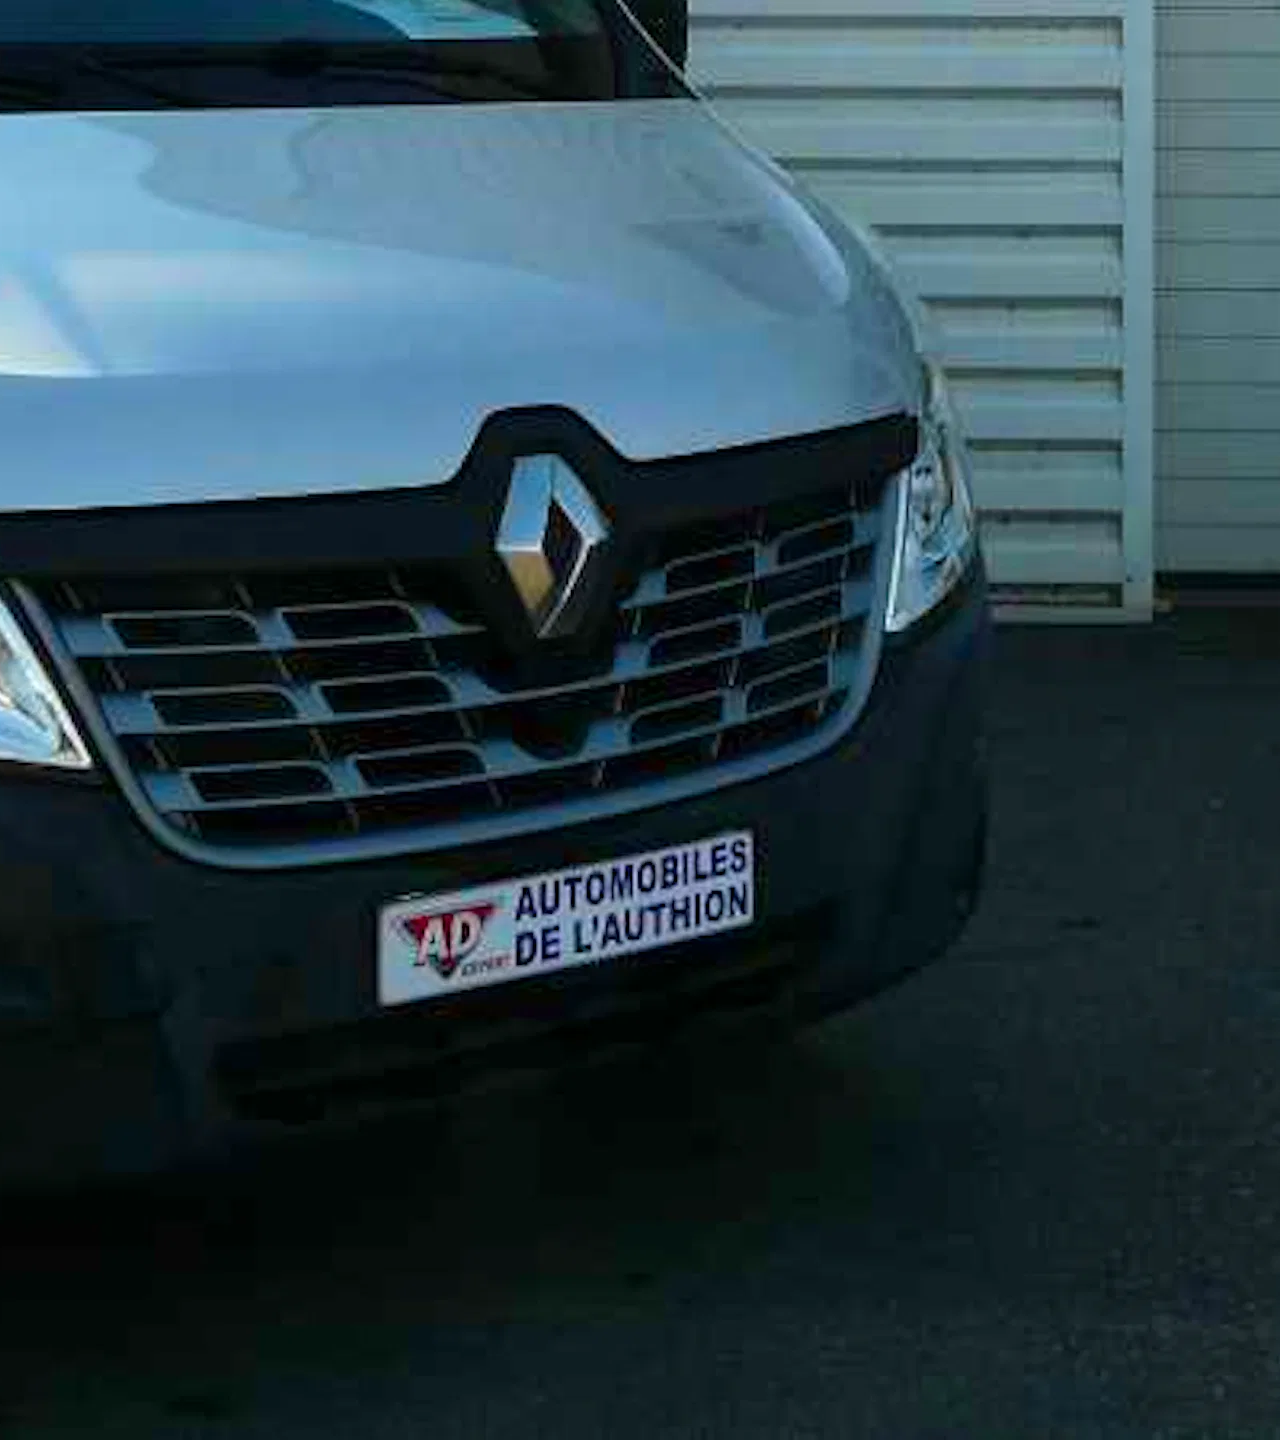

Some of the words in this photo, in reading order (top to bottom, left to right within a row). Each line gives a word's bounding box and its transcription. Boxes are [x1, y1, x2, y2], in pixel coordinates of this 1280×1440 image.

[412, 908, 482, 968] AD
[514, 838, 748, 921] AUTOMOBILES
[514, 925, 561, 967] DE
[573, 882, 749, 954] L'AUTHION
